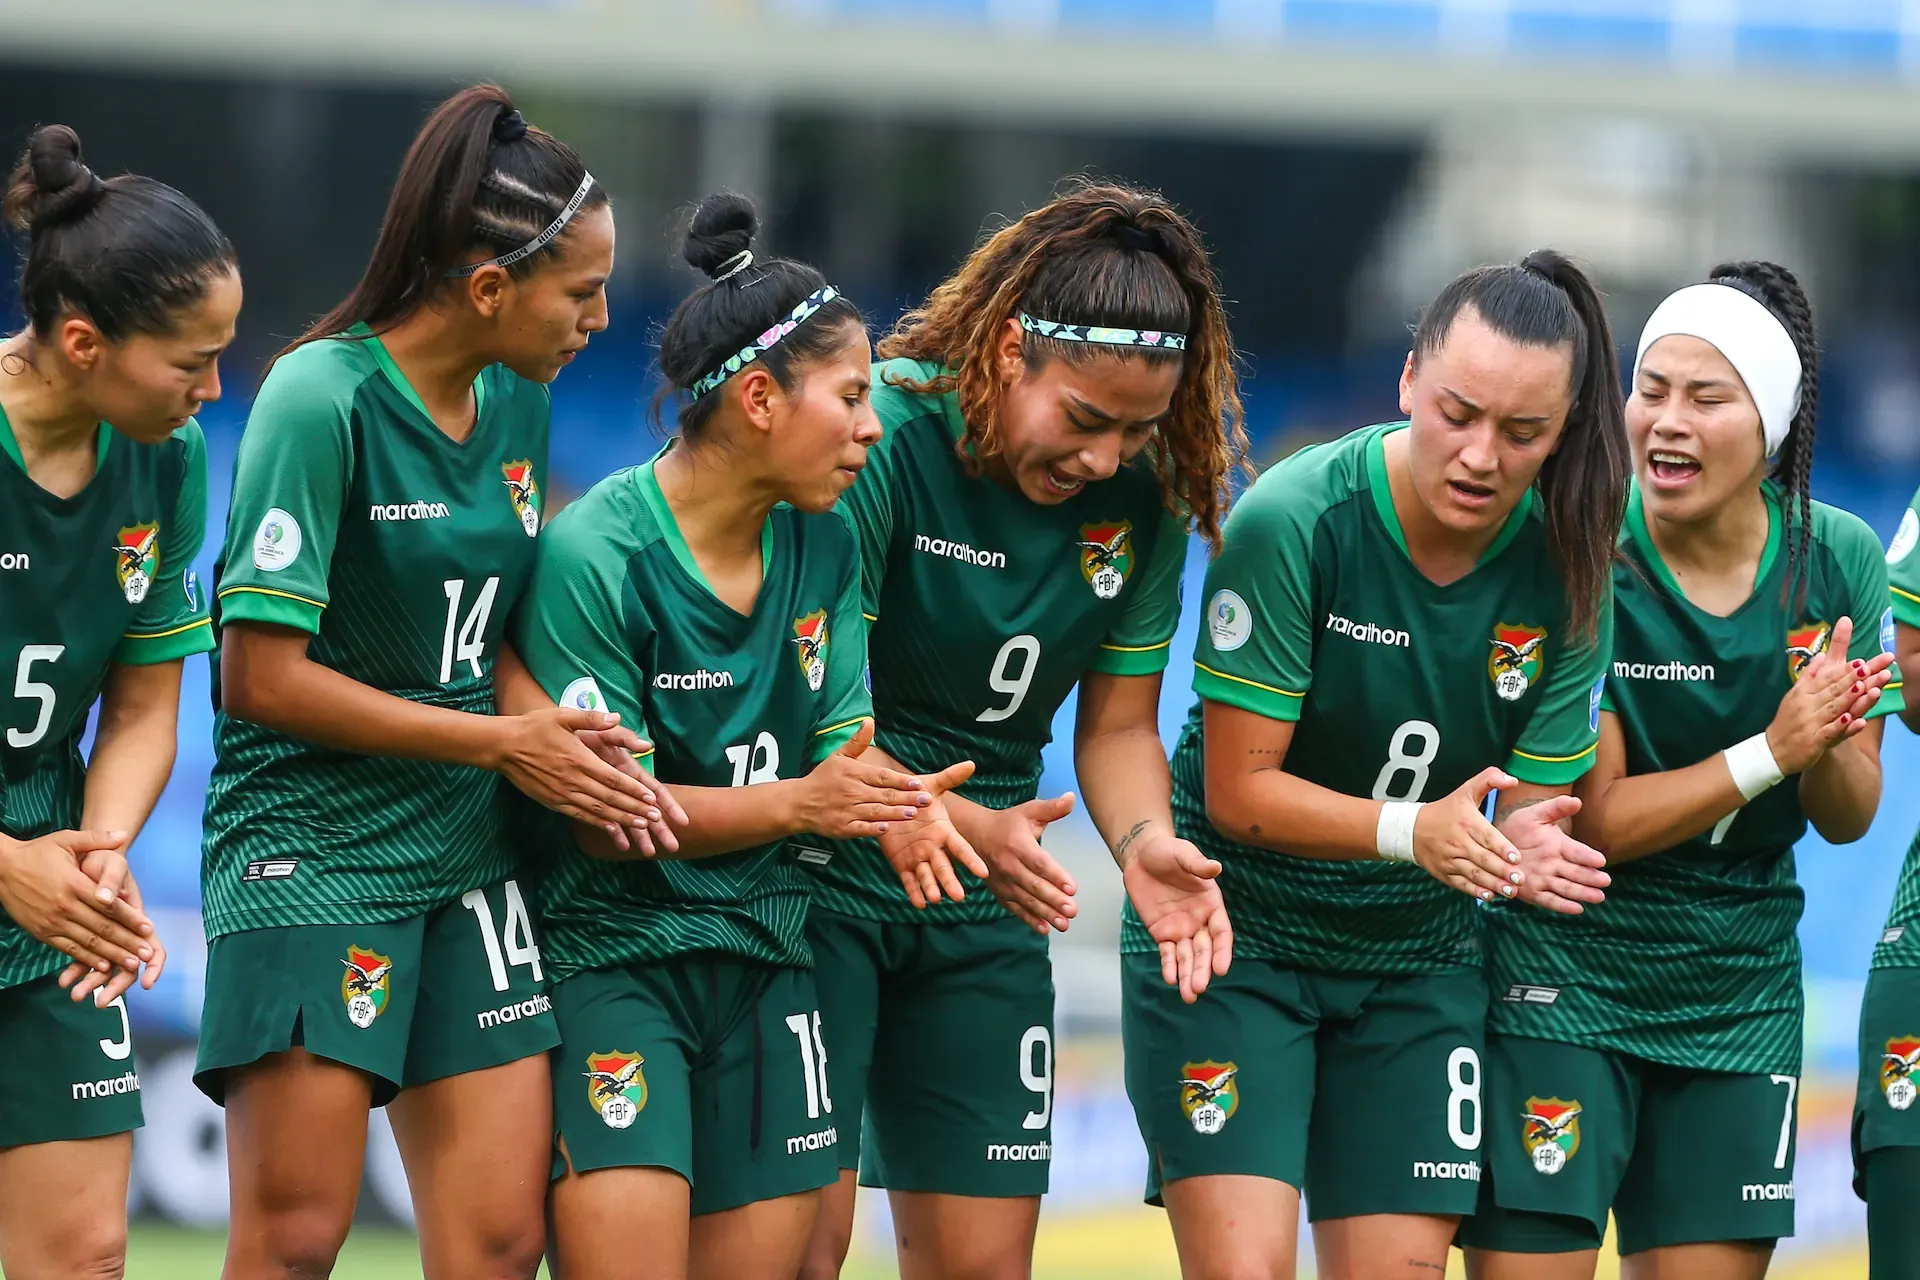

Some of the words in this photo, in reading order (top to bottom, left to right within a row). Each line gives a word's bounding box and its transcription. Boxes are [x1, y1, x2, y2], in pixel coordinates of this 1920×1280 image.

[370, 500, 450, 520] marathon
[915, 534, 1006, 568] marathon
[1098, 573, 1116, 591] FBF
[439, 576, 500, 683] 14
[652, 669, 733, 690] arathon
[975, 634, 1041, 722] 9
[1502, 675, 1521, 693] FBF
[1613, 660, 1715, 681] marathon
[7, 644, 66, 748] 5
[1372, 720, 1440, 802] 8
[461, 880, 544, 991] 14
[352, 1001, 371, 1020] FBF
[1020, 1025, 1052, 1130] 9
[609, 1103, 629, 1121] FBF
[1447, 1046, 1482, 1151] 8
[1198, 1110, 1217, 1127] FBF
[1769, 1074, 1798, 1169] 7
[1539, 1149, 1558, 1166] FBF
